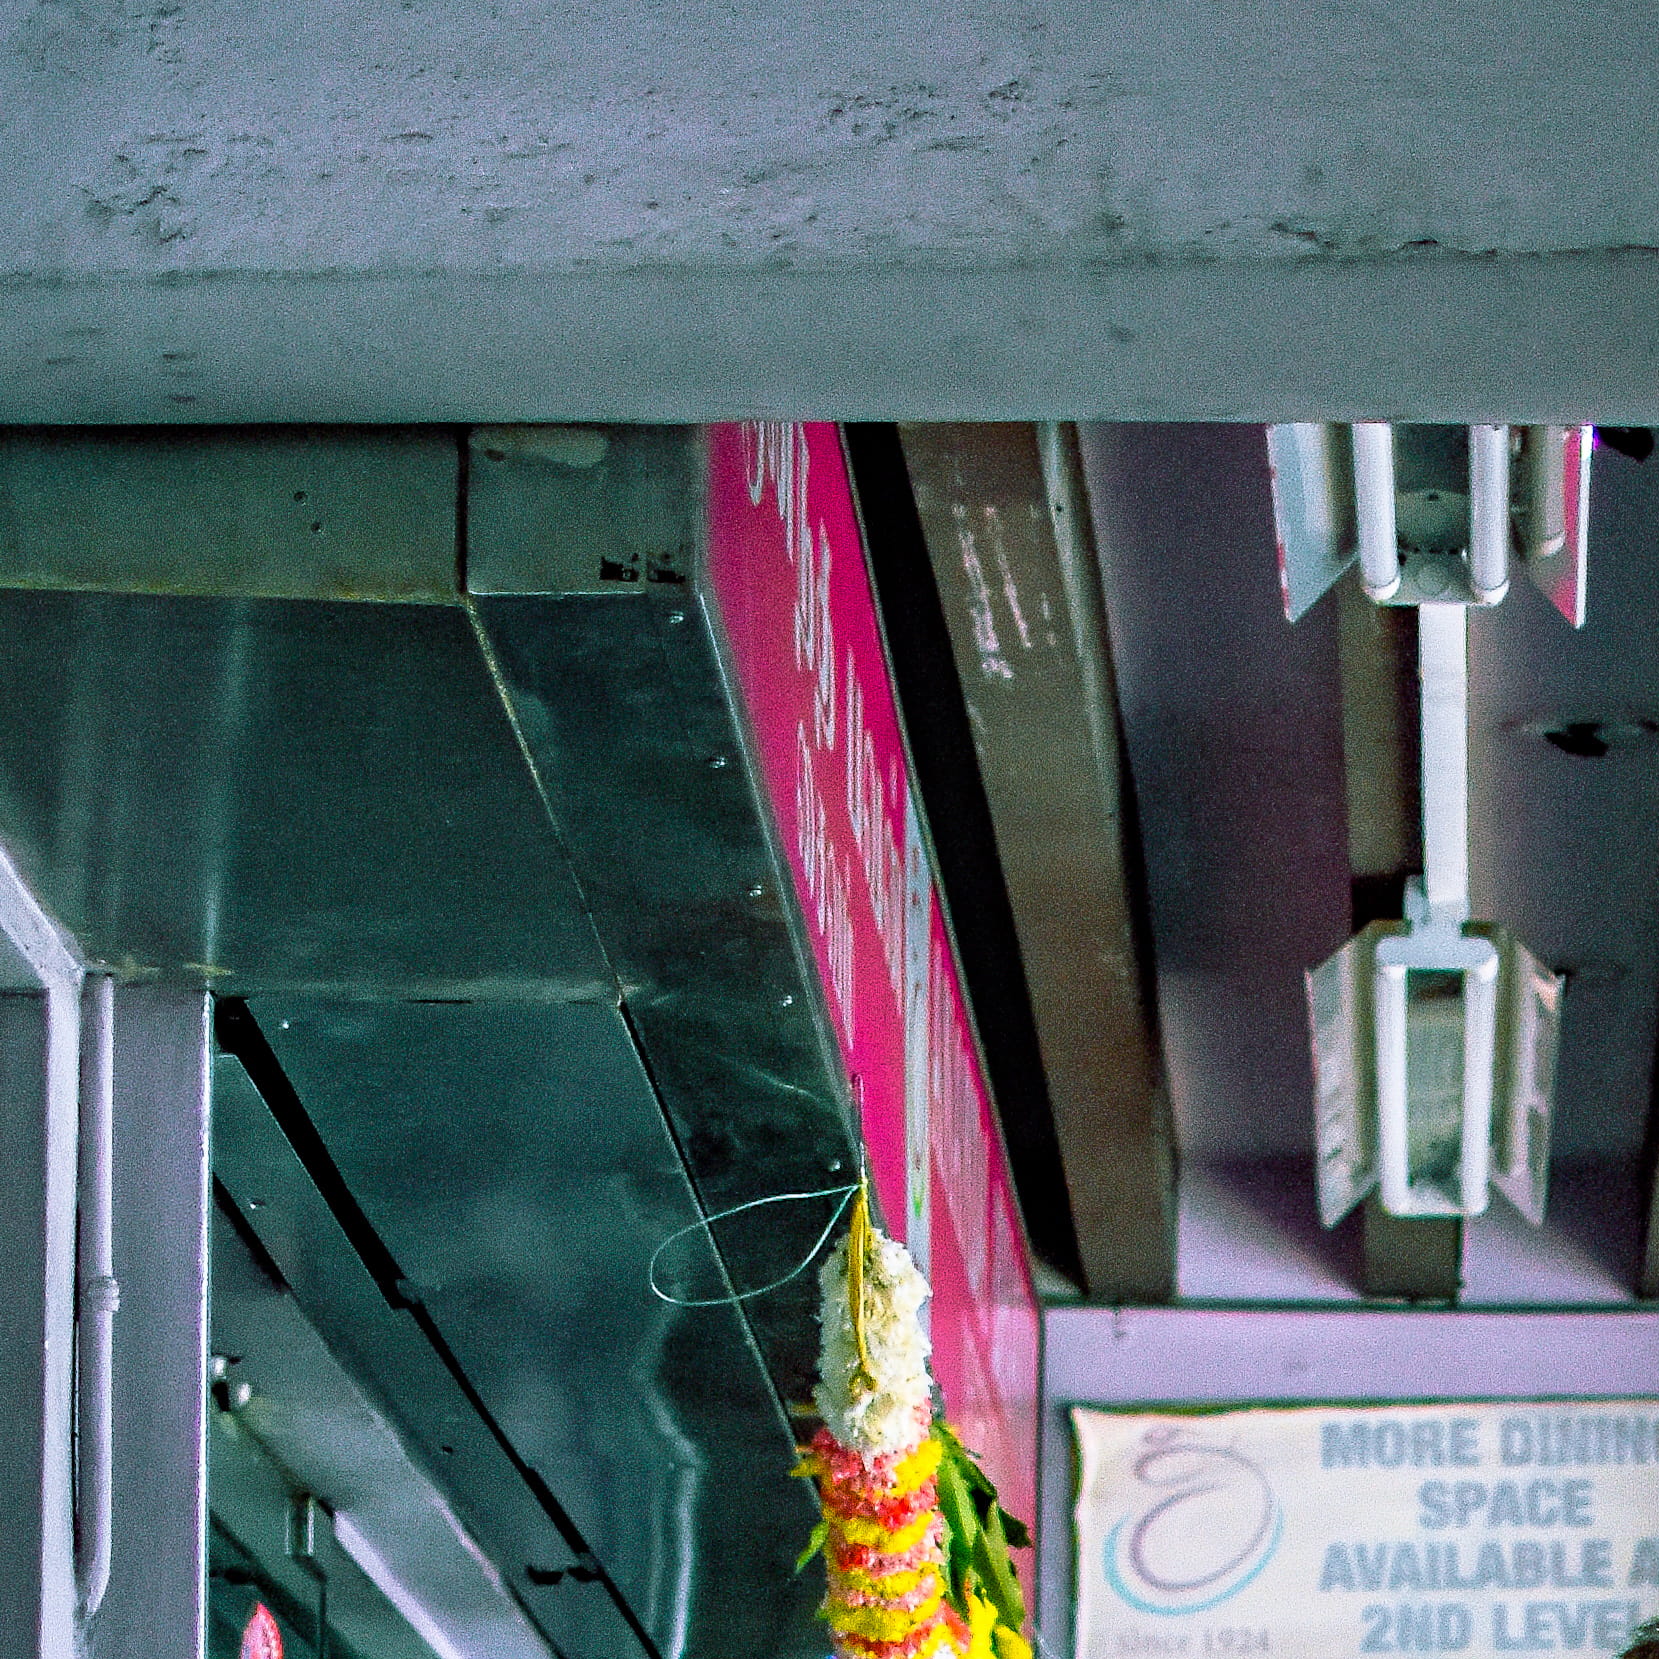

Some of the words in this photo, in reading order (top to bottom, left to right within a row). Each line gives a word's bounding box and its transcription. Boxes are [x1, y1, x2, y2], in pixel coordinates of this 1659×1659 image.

[1319, 1418, 1481, 1469] MORE
[1418, 1478, 1594, 1530] SPACE
[1318, 1538, 1614, 1592] AVAILABLE
[1359, 1603, 1473, 1653] 2ND
